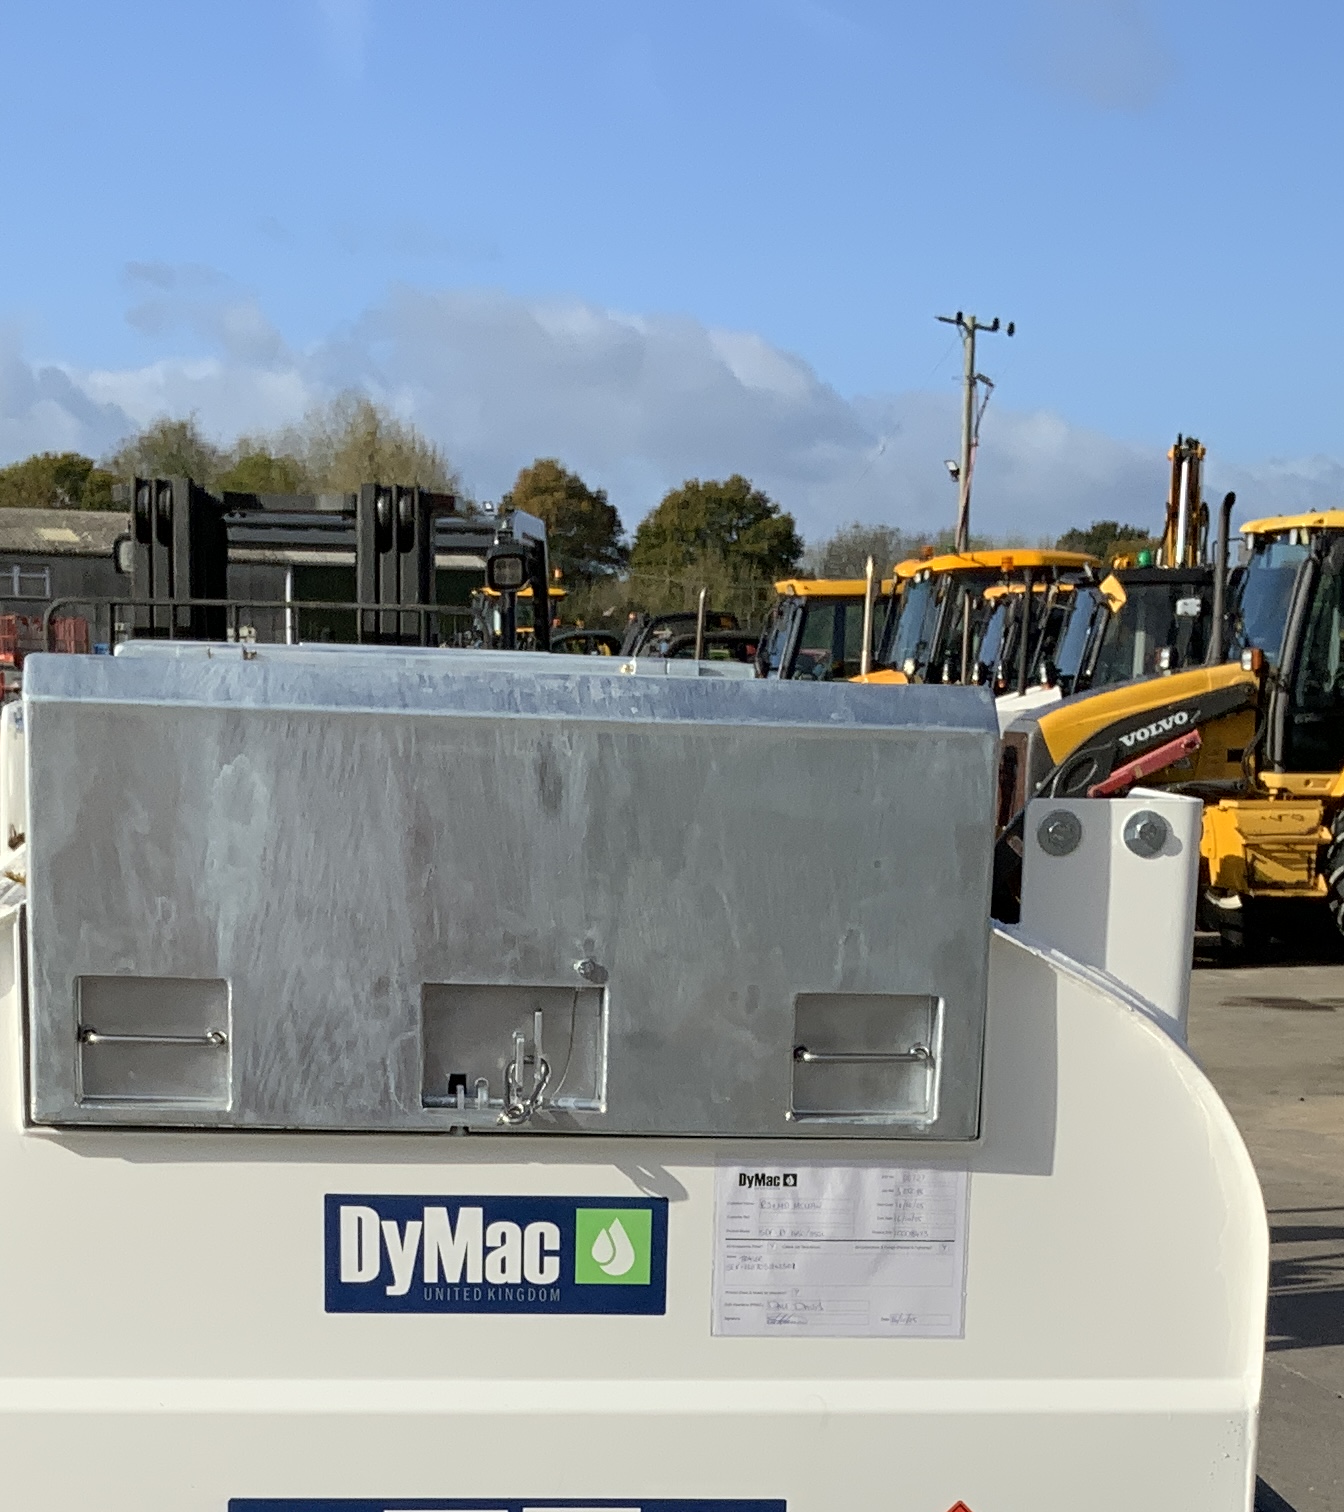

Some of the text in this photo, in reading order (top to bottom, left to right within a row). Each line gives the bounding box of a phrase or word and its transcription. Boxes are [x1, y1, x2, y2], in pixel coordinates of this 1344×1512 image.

[1118, 711, 1189, 747] VOLVO
[739, 1173, 780, 1188] DyMac
[340, 1205, 560, 1296] DyMac
[423, 1287, 561, 1302] UNITED KINGDOM
